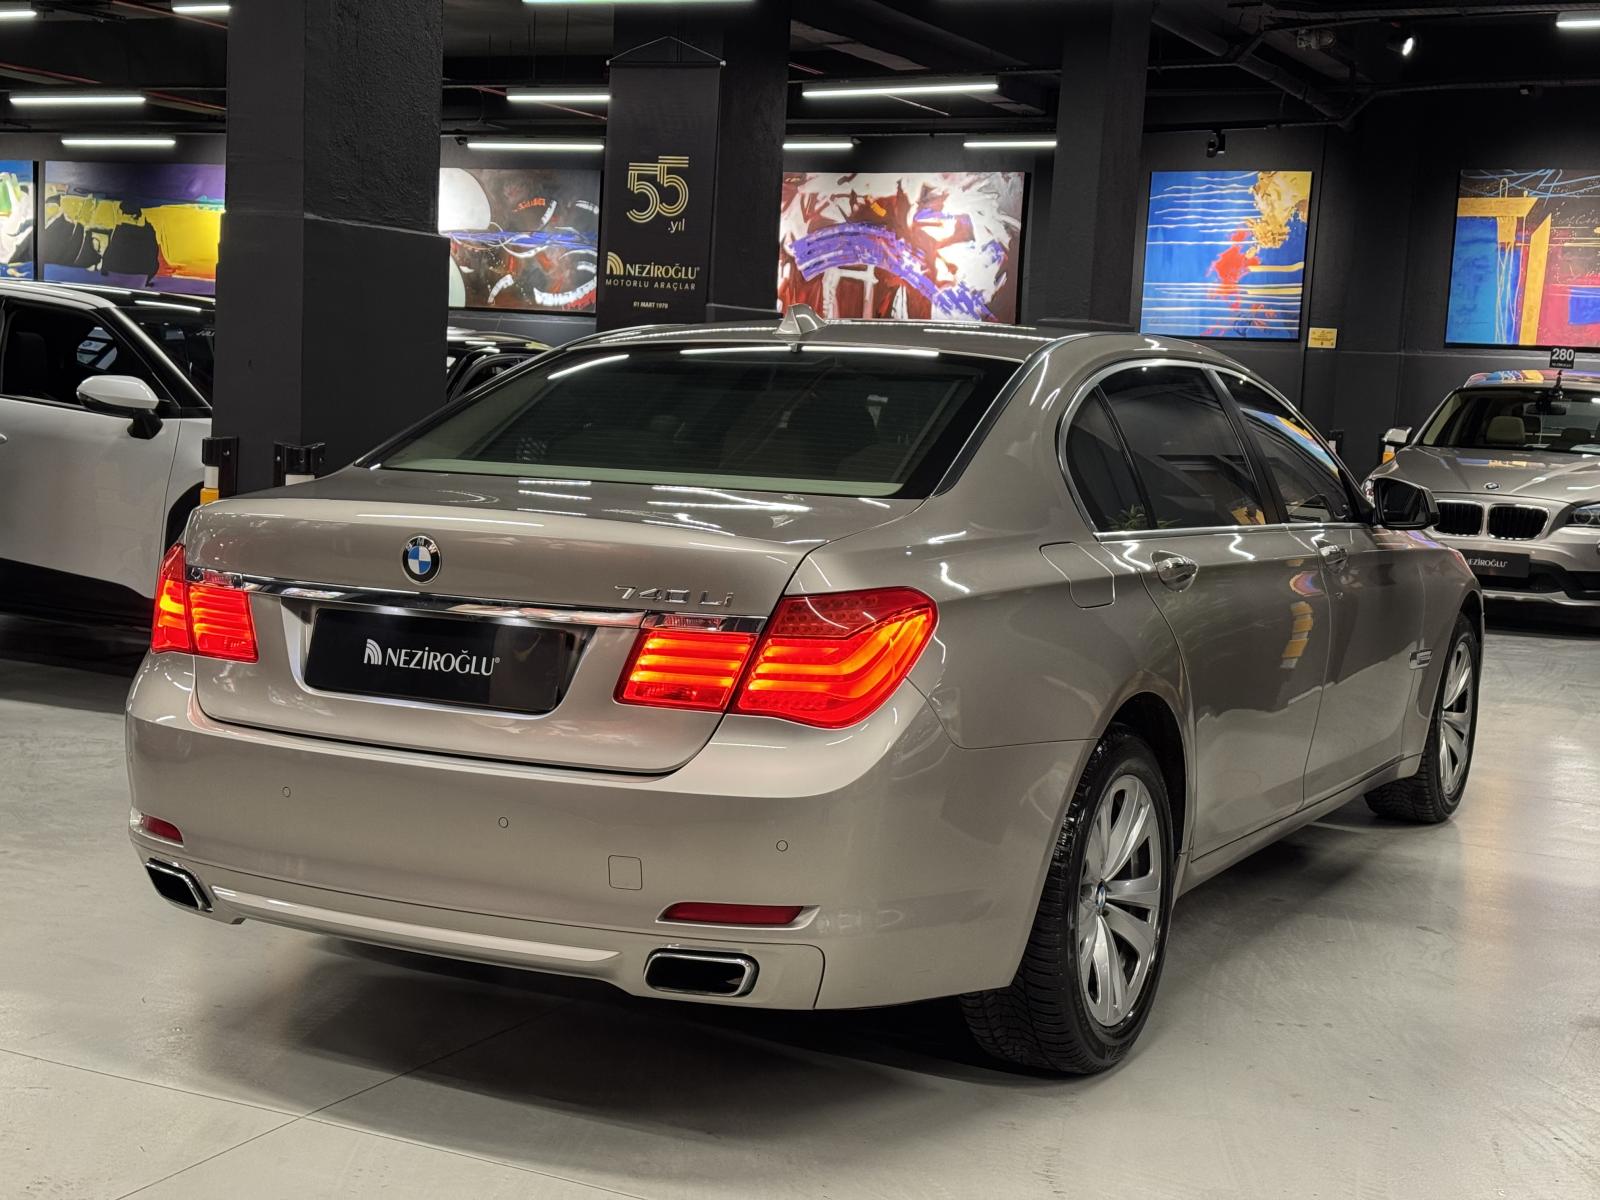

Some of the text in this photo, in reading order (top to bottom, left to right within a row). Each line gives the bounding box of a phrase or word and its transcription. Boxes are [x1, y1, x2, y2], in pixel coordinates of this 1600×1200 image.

[626, 155, 690, 223] 55
[605, 278, 696, 292] MOTORLU ARAÇLAR
[1551, 347, 1575, 361] 280
[385, 646, 496, 676] NEZİROĞLU
